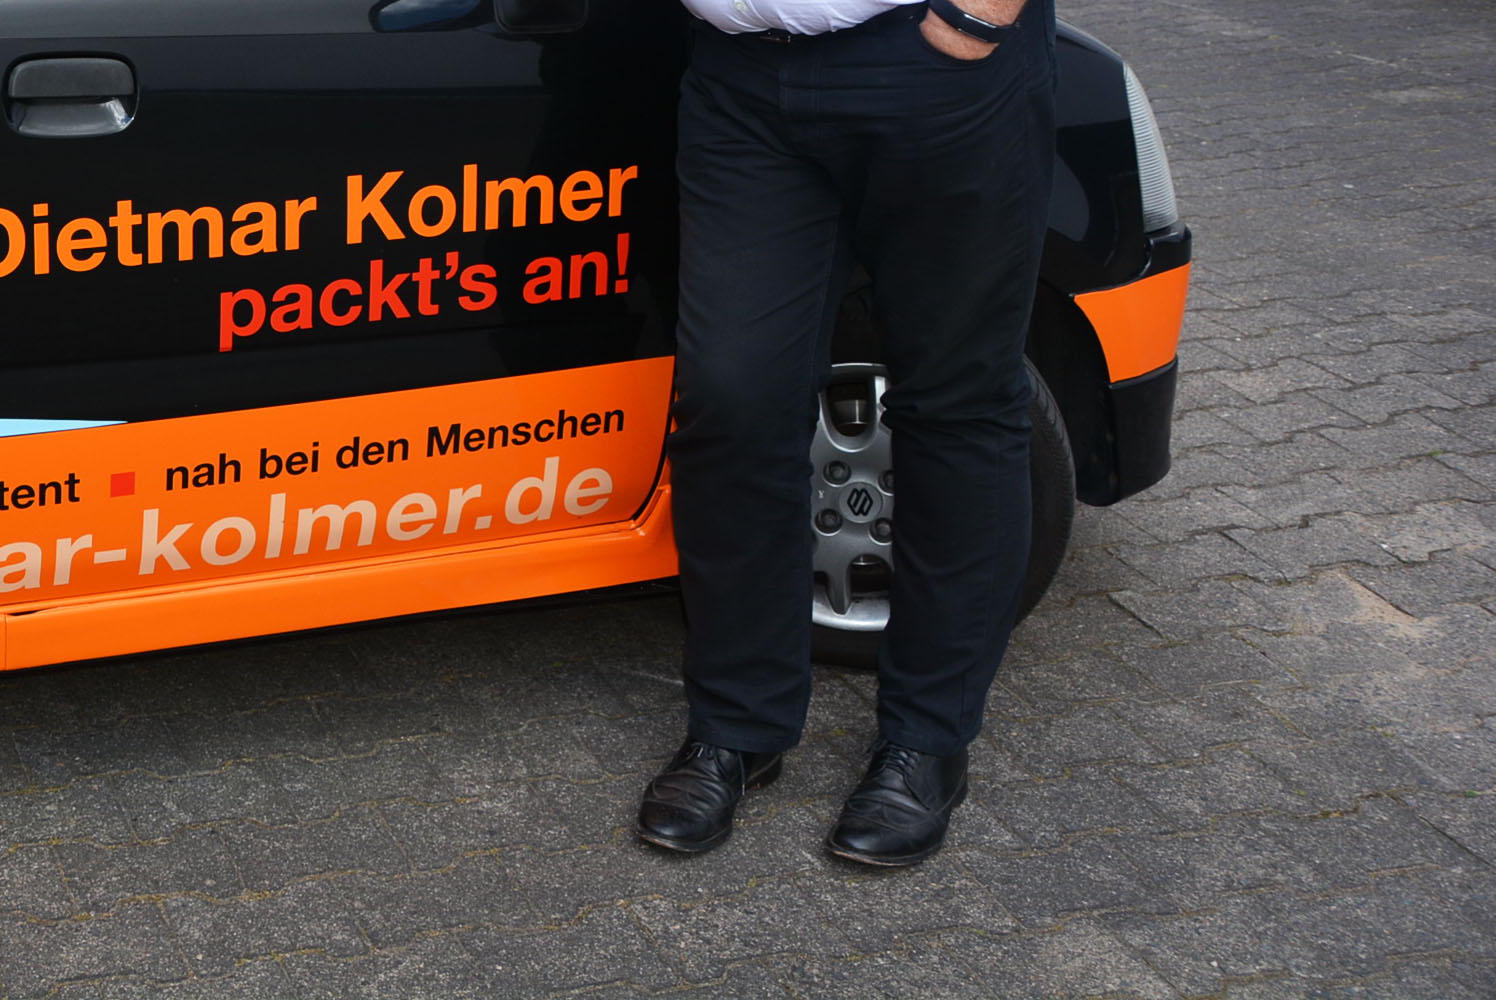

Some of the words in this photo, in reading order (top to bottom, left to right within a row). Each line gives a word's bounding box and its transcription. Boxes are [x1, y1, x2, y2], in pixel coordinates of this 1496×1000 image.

[346, 163, 639, 245] Kolmer
[522, 232, 631, 305] an!
[165, 453, 242, 491] nah
[259, 442, 320, 479] bei
[336, 436, 409, 469] den
[427, 409, 625, 457] Menschen
